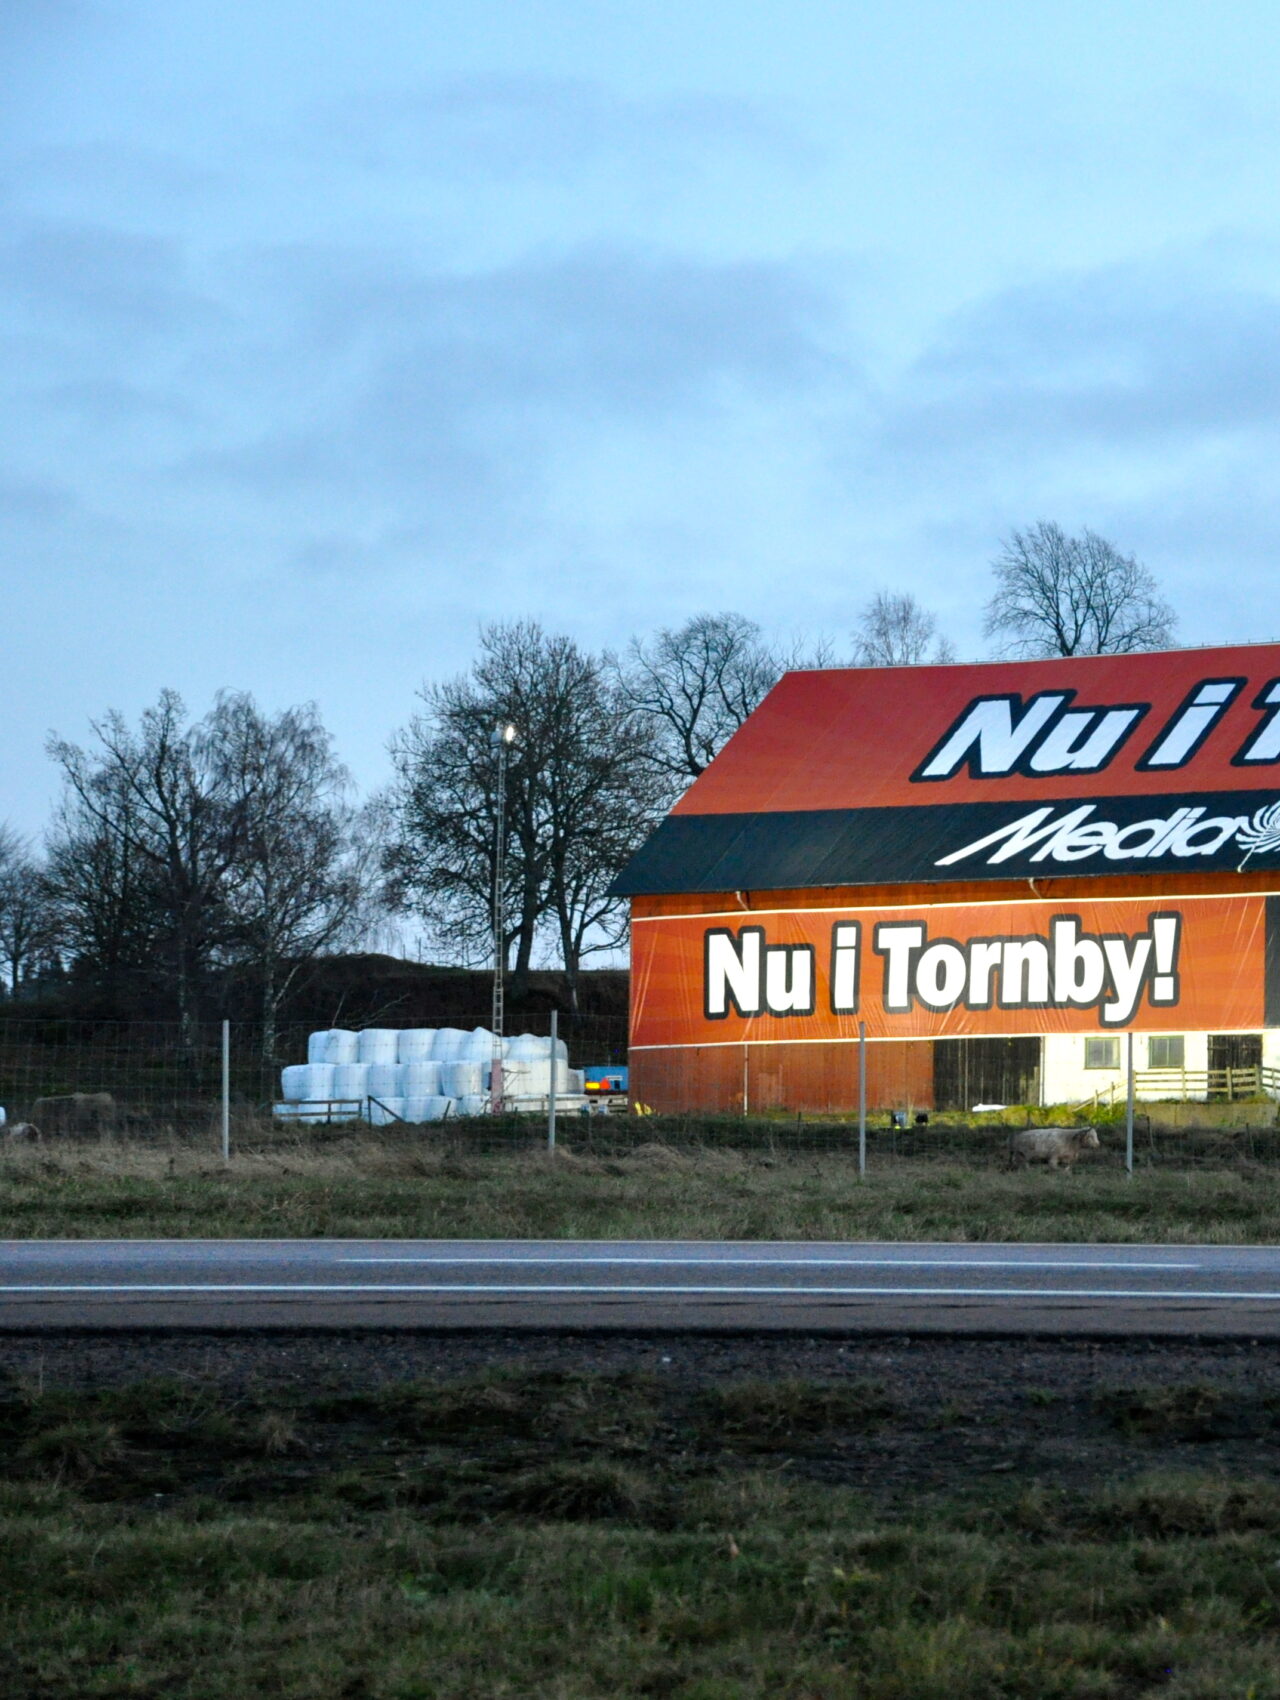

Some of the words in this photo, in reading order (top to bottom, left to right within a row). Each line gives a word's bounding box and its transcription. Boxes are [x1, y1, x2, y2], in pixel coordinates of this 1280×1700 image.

[922, 697, 1128, 777] Nu
[1147, 681, 1236, 768] i
[933, 804, 1250, 866] Media
[706, 931, 812, 1014] Nu
[834, 926, 857, 1009] i
[876, 917, 1177, 1022] Tornby!
